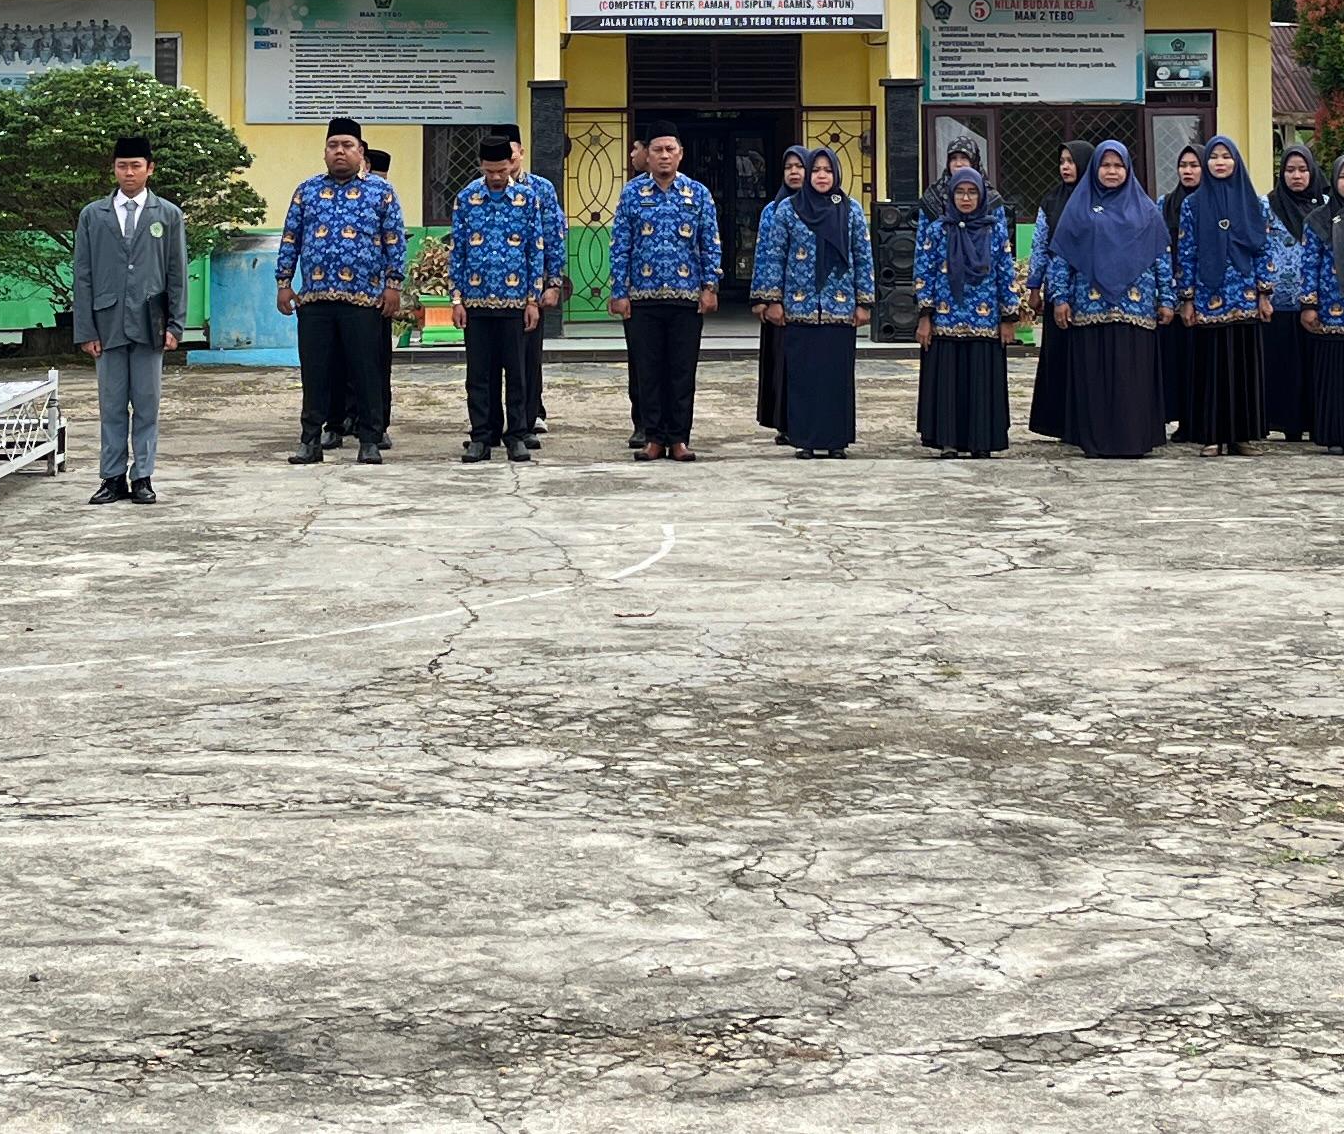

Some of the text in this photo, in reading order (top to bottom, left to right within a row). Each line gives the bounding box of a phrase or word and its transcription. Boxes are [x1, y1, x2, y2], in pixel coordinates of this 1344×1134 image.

[735, 0, 775, 11] DISIPLIN,
[777, 0, 814, 11] AGAMIS,
[816, 0, 854, 11] SANTUN)
[975, 0, 1095, 18] 5 NILAI BUDAYA KERJA
[1014, 10, 1074, 21] MAN 2 TEBO
[600, 18, 627, 28] JALAN
[629, 18, 659, 28] LINTAS
[749, 18, 772, 27] TEBO
[773, 18, 808, 27] TENGAH
[831, 17, 855, 27] TEBO
